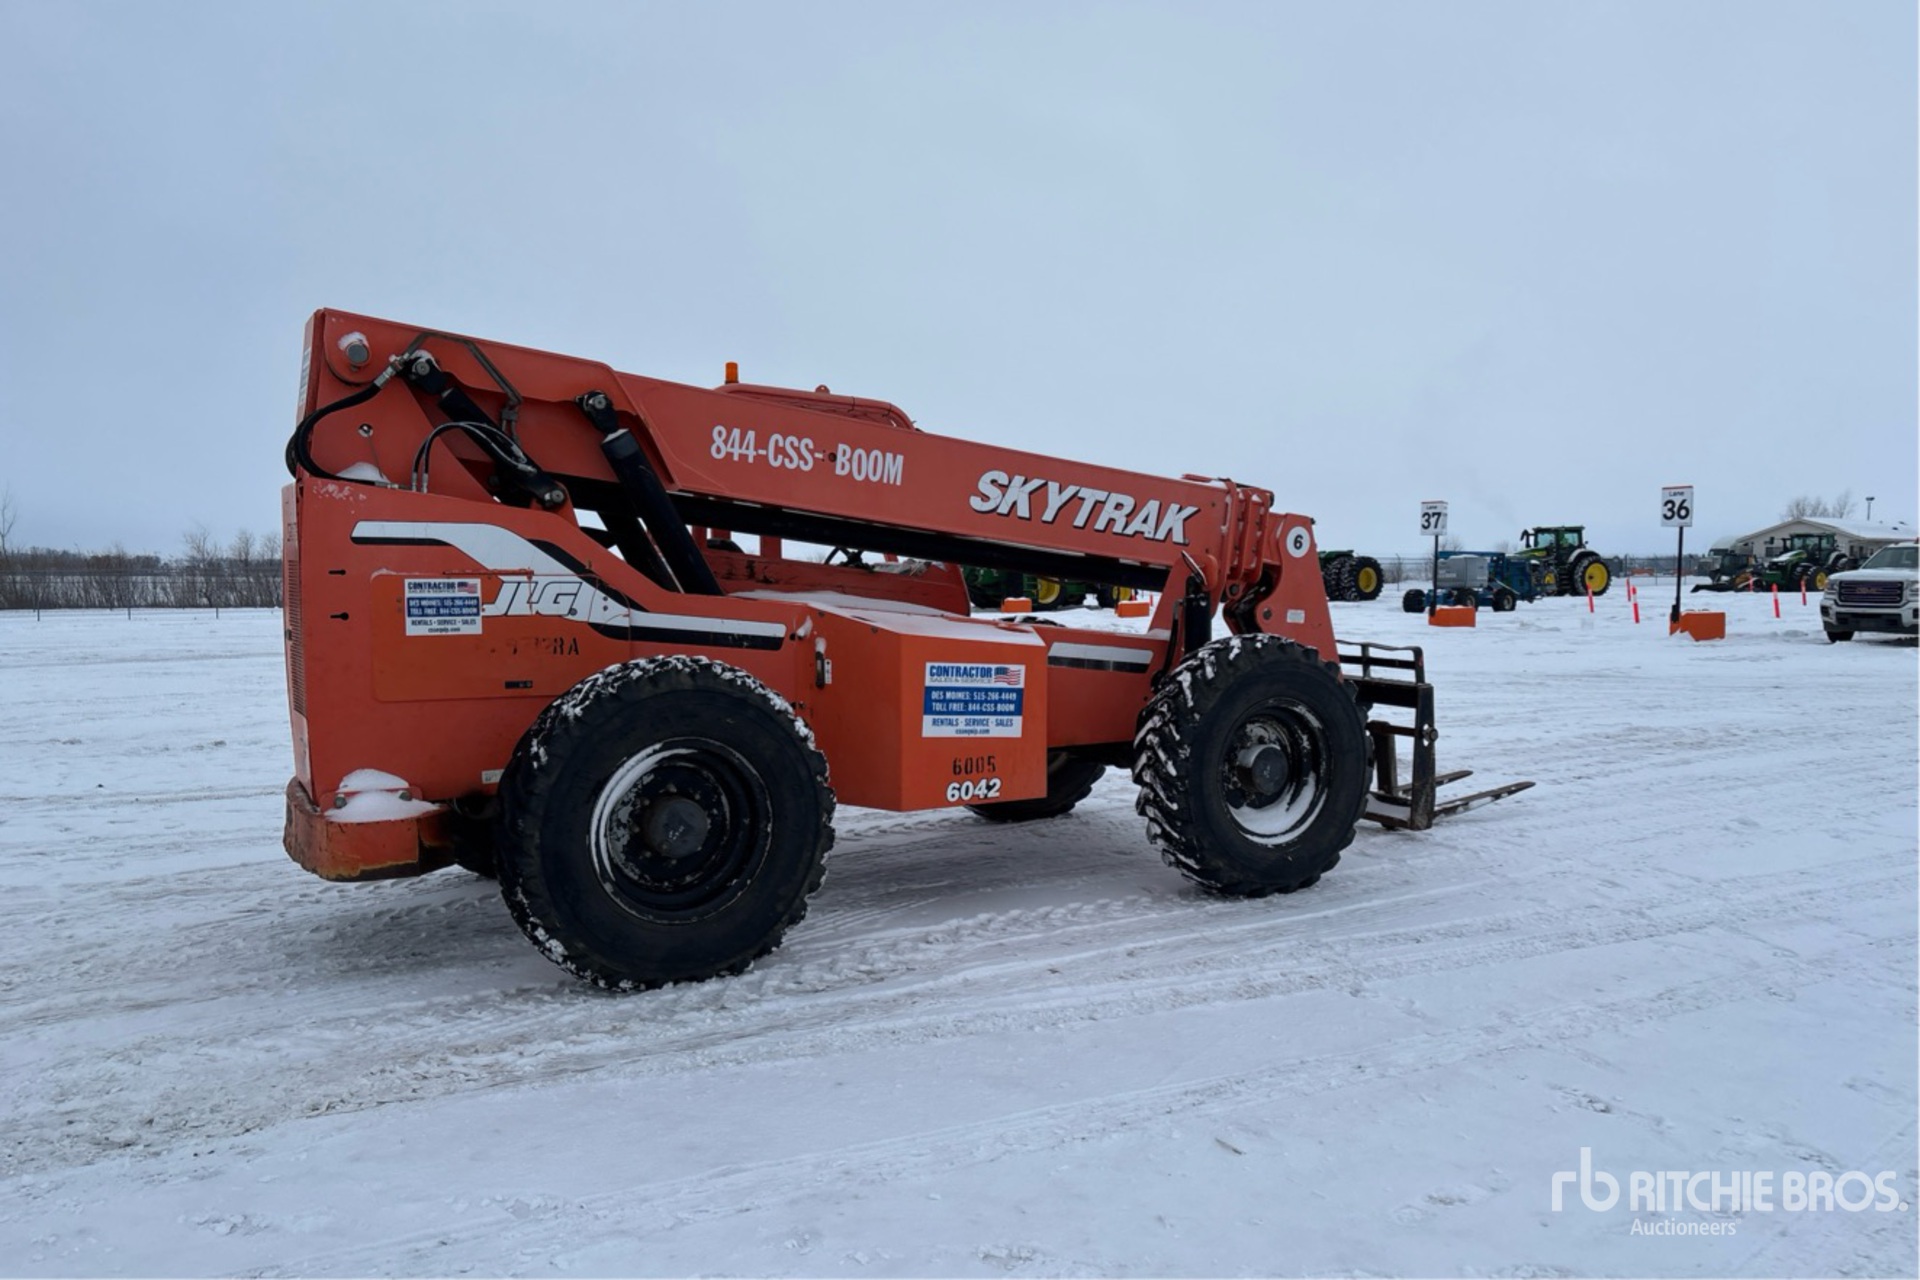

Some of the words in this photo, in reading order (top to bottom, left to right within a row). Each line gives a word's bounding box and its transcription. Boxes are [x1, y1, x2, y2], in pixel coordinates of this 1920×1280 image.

[835, 443, 904, 486] BOOM
[969, 470, 1199, 545] SKYTRAK
[1662, 499, 1690, 521] 36
[1421, 512, 1442, 530] 37
[1293, 534, 1303, 551] 6
[481, 581, 583, 617] JLG
[929, 665, 993, 678] CONTRACTOR
[931, 690, 944, 700] DES
[945, 691, 972, 700] MOINES:
[932, 702, 947, 711] TOLL
[948, 702, 966, 711] FREE:
[968, 703, 1016, 712] 844-CSS-BOOM
[932, 718, 960, 727] RENTALS
[964, 718, 990, 727] SERVICE
[995, 718, 1014, 727] SALES
[952, 755, 996, 775] 6005
[946, 777, 1002, 802] 6042
